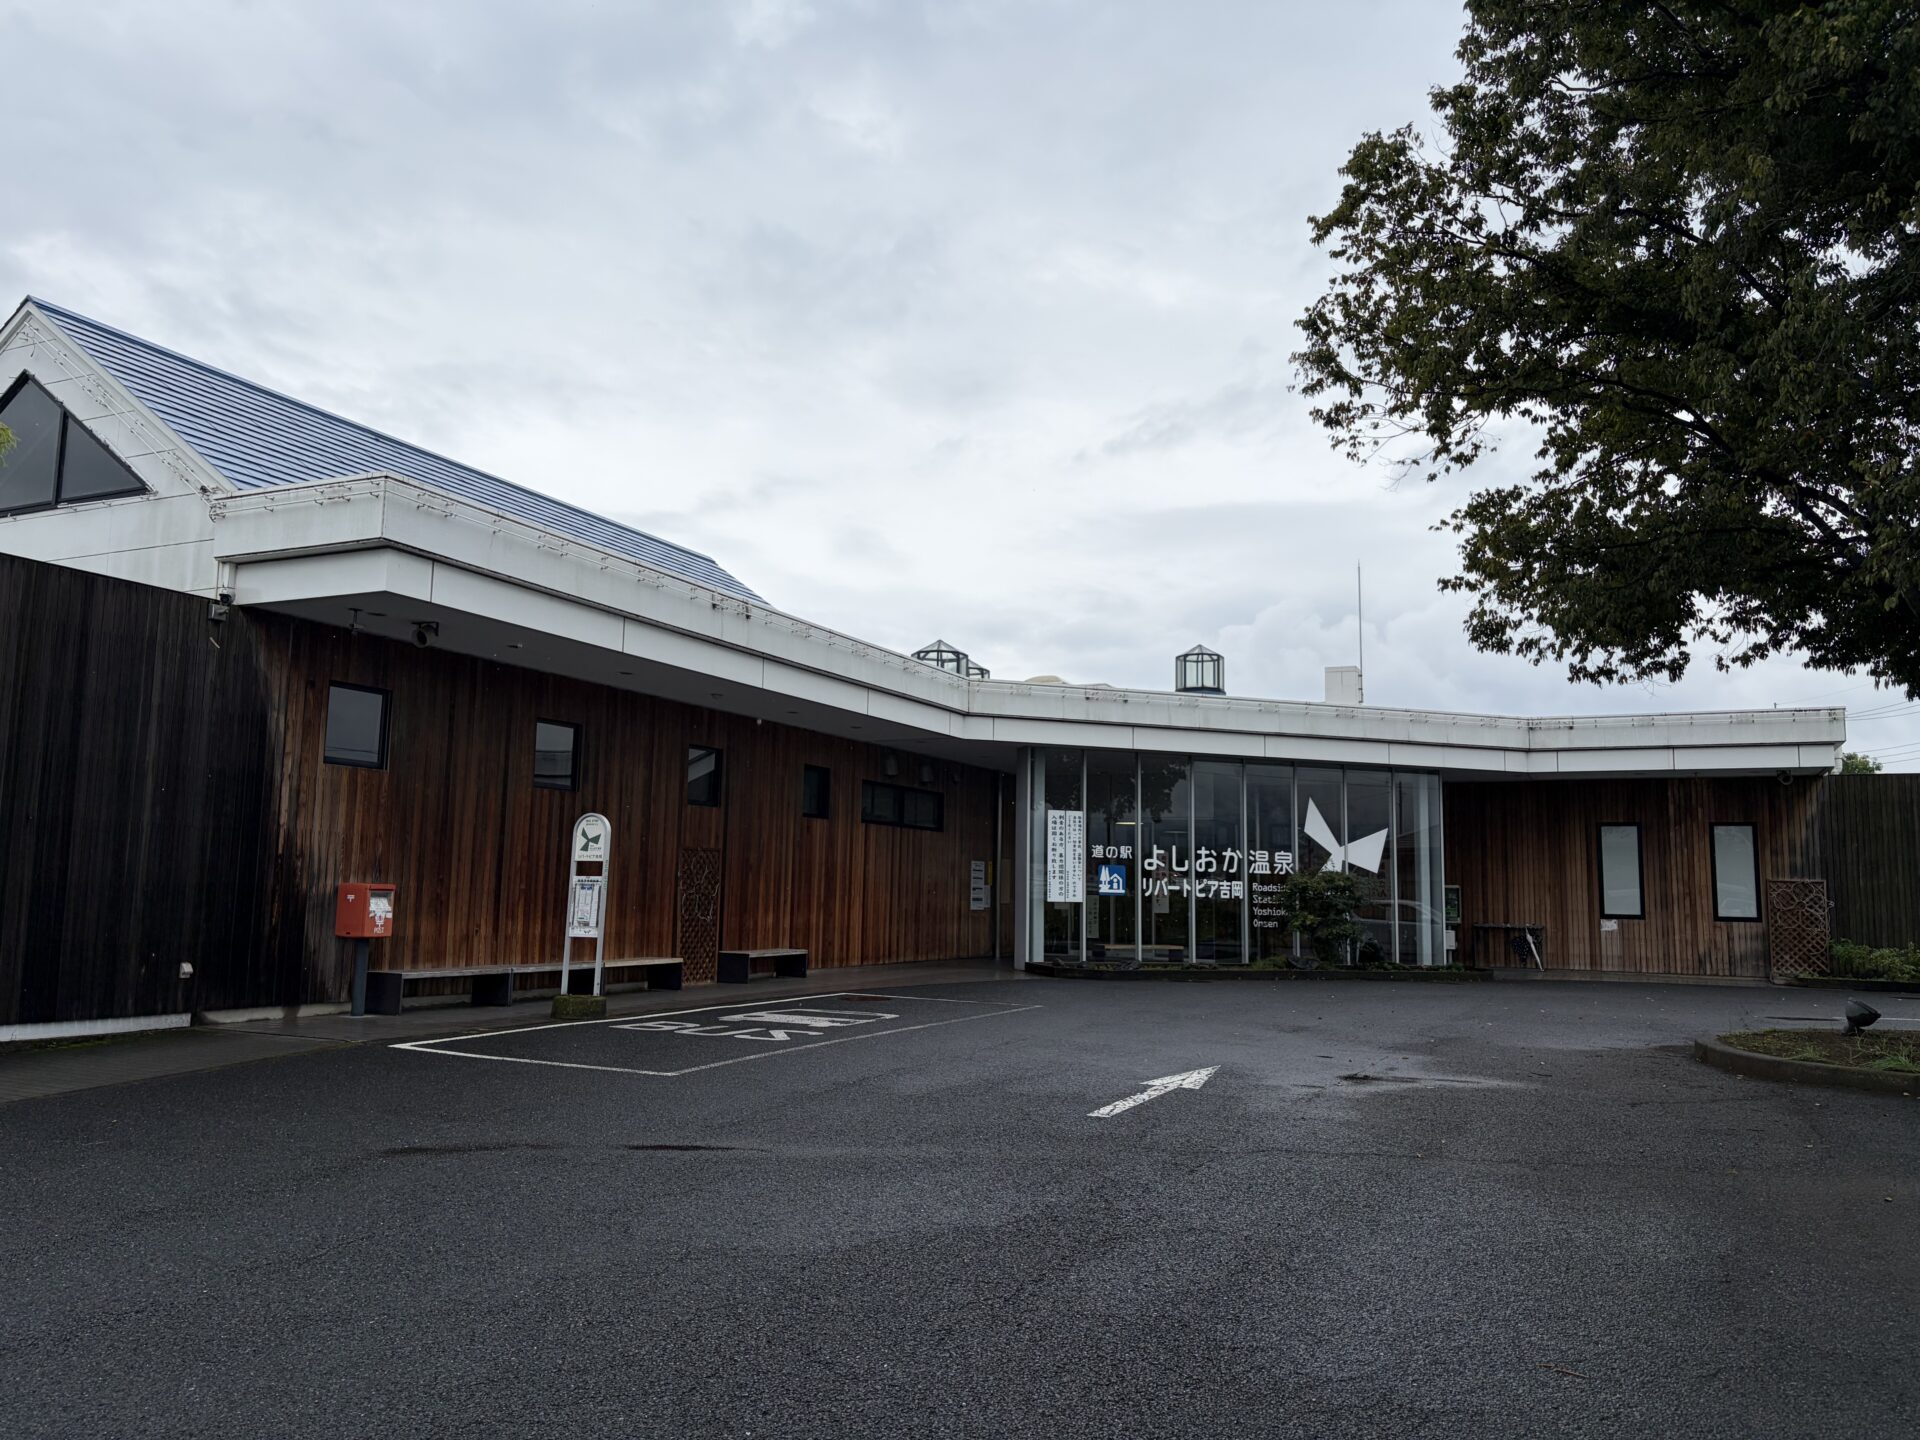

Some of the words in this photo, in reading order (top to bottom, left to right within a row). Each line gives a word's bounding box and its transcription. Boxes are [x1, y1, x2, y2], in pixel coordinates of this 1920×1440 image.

[1091, 844, 1133, 859] 道の駅
[1143, 844, 1294, 875] よしおか温泉
[1142, 877, 1244, 899] リバートピア吉岡
[1252, 919, 1279, 928] Onsen
[609, 1021, 825, 1041] BUS
